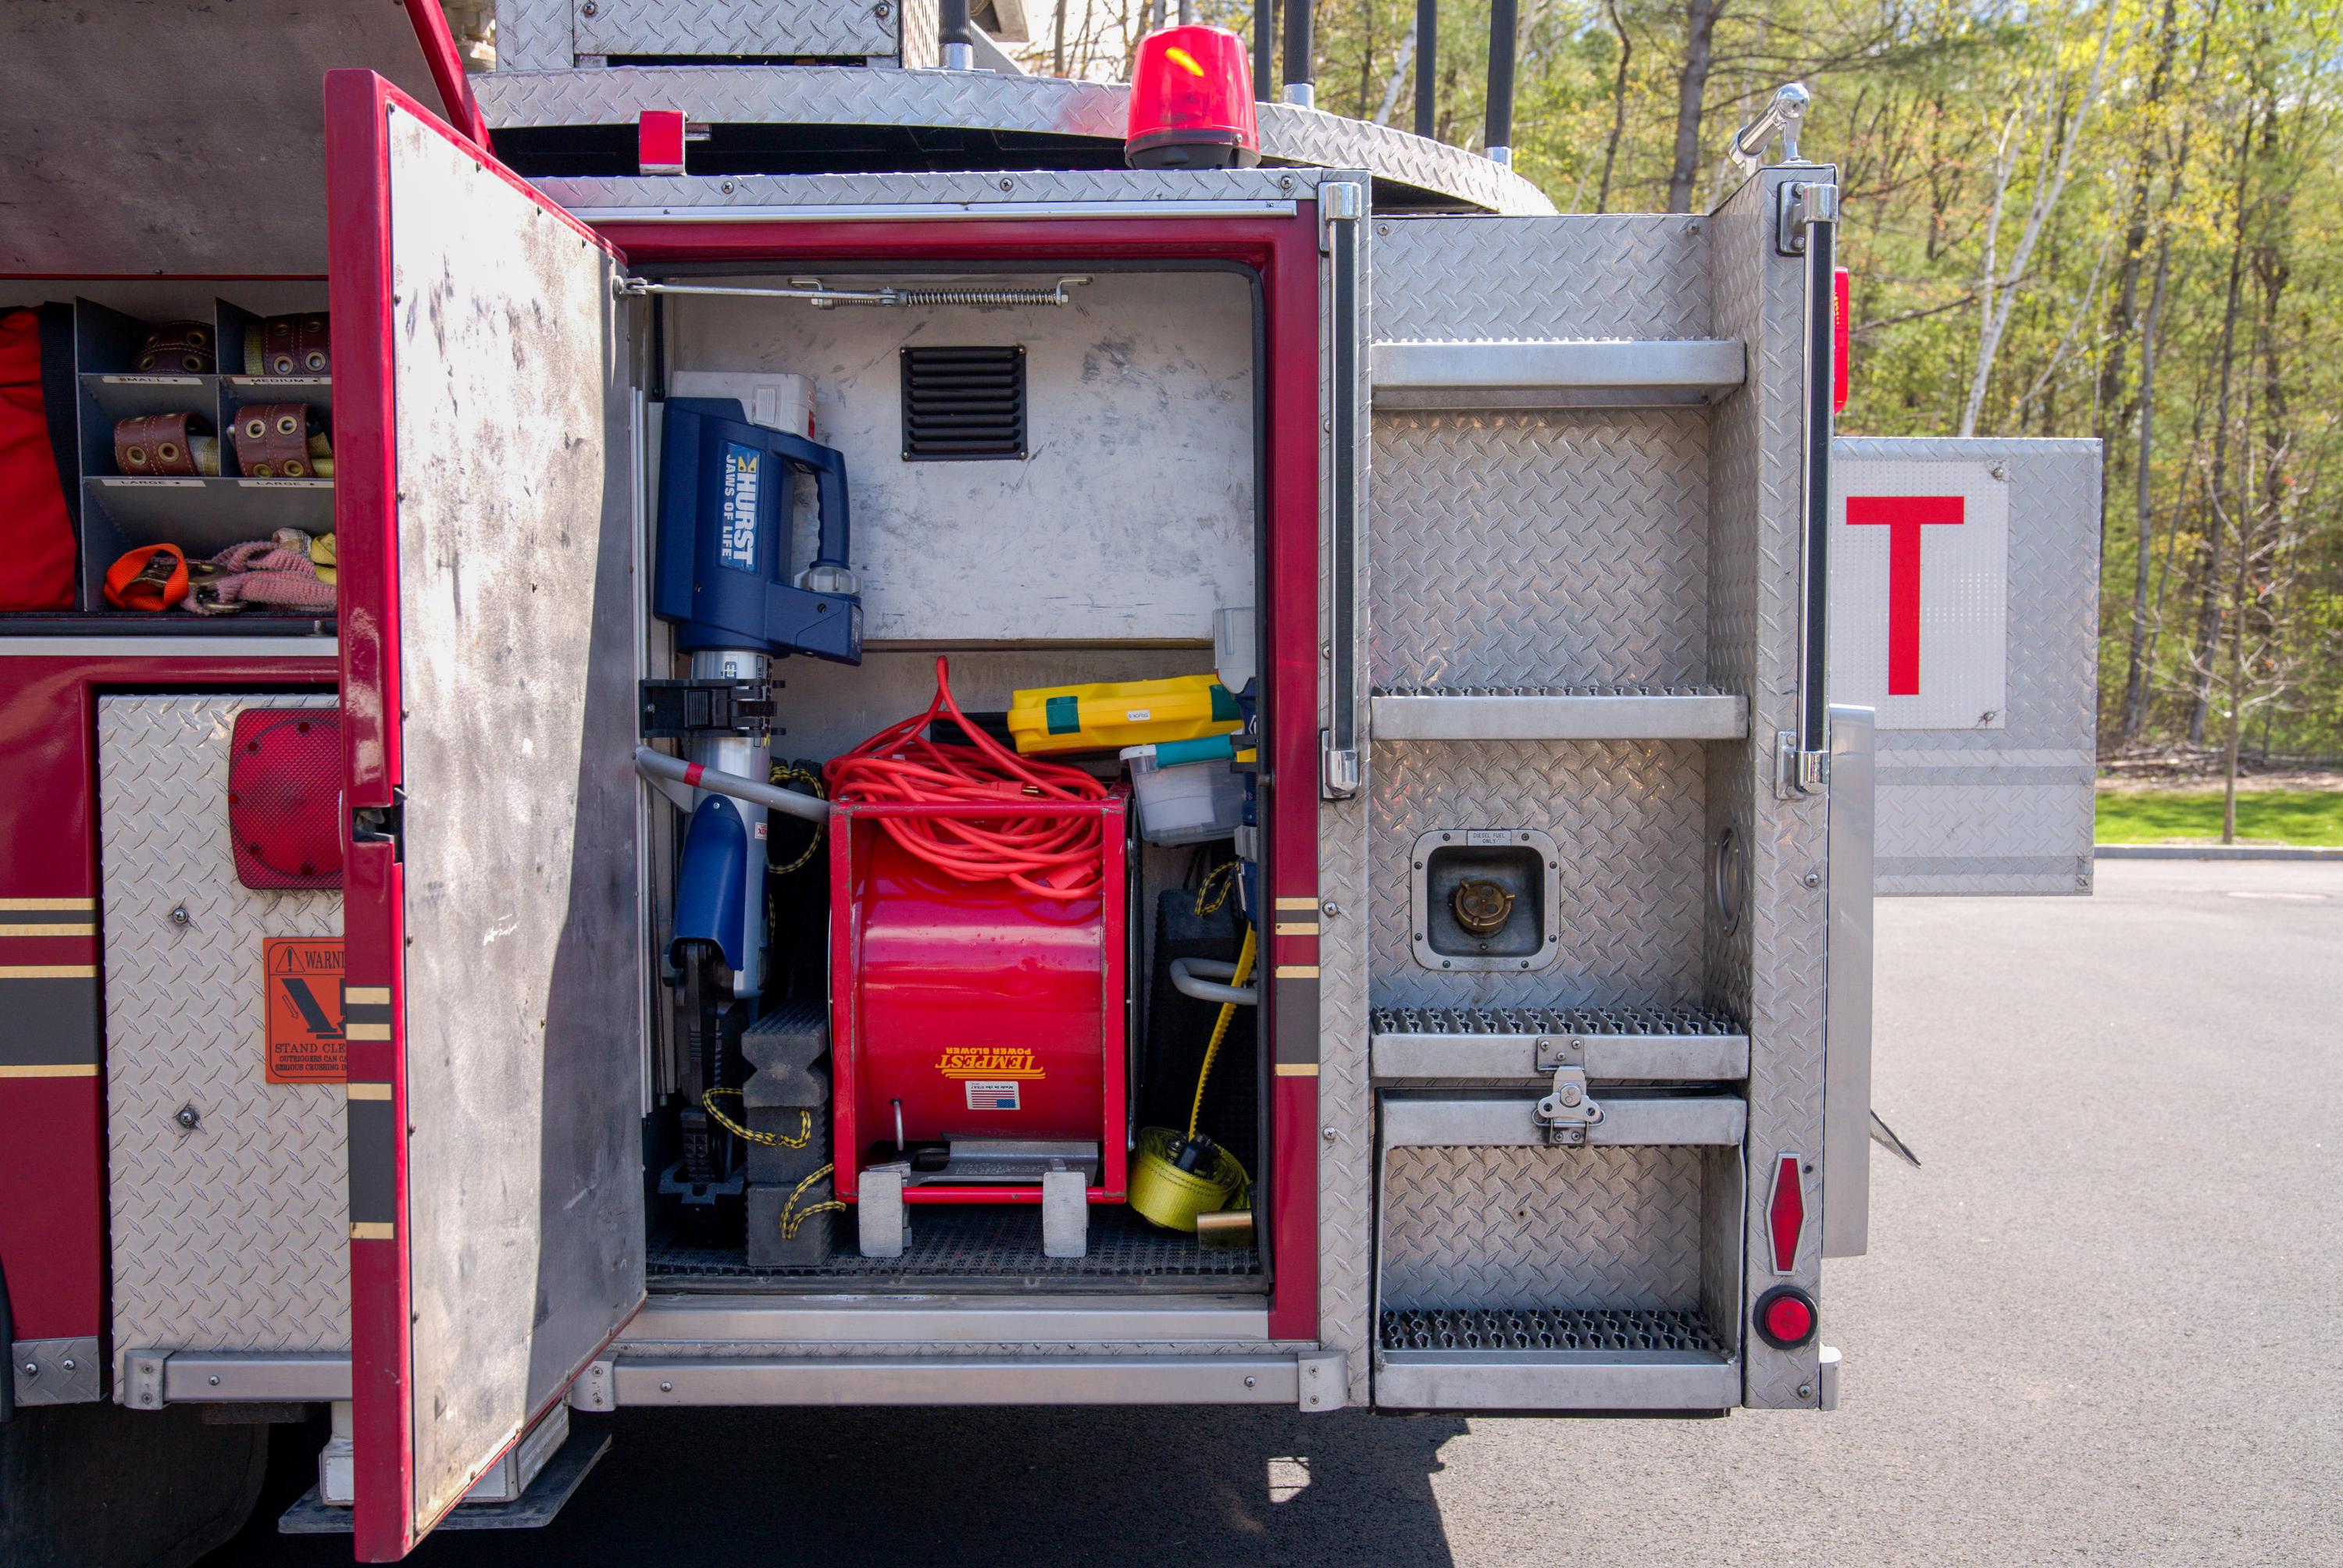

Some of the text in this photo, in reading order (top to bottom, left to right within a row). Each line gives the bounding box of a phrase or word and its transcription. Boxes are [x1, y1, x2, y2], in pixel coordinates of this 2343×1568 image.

[722, 454, 736, 557] JAWS OF LIFE
[733, 472, 757, 565] HURST
[1846, 496, 1965, 696] T
[305, 950, 345, 969] WARNI
[275, 1043, 346, 1053] STAND CLE
[935, 1055, 1044, 1073] TEMPEST
